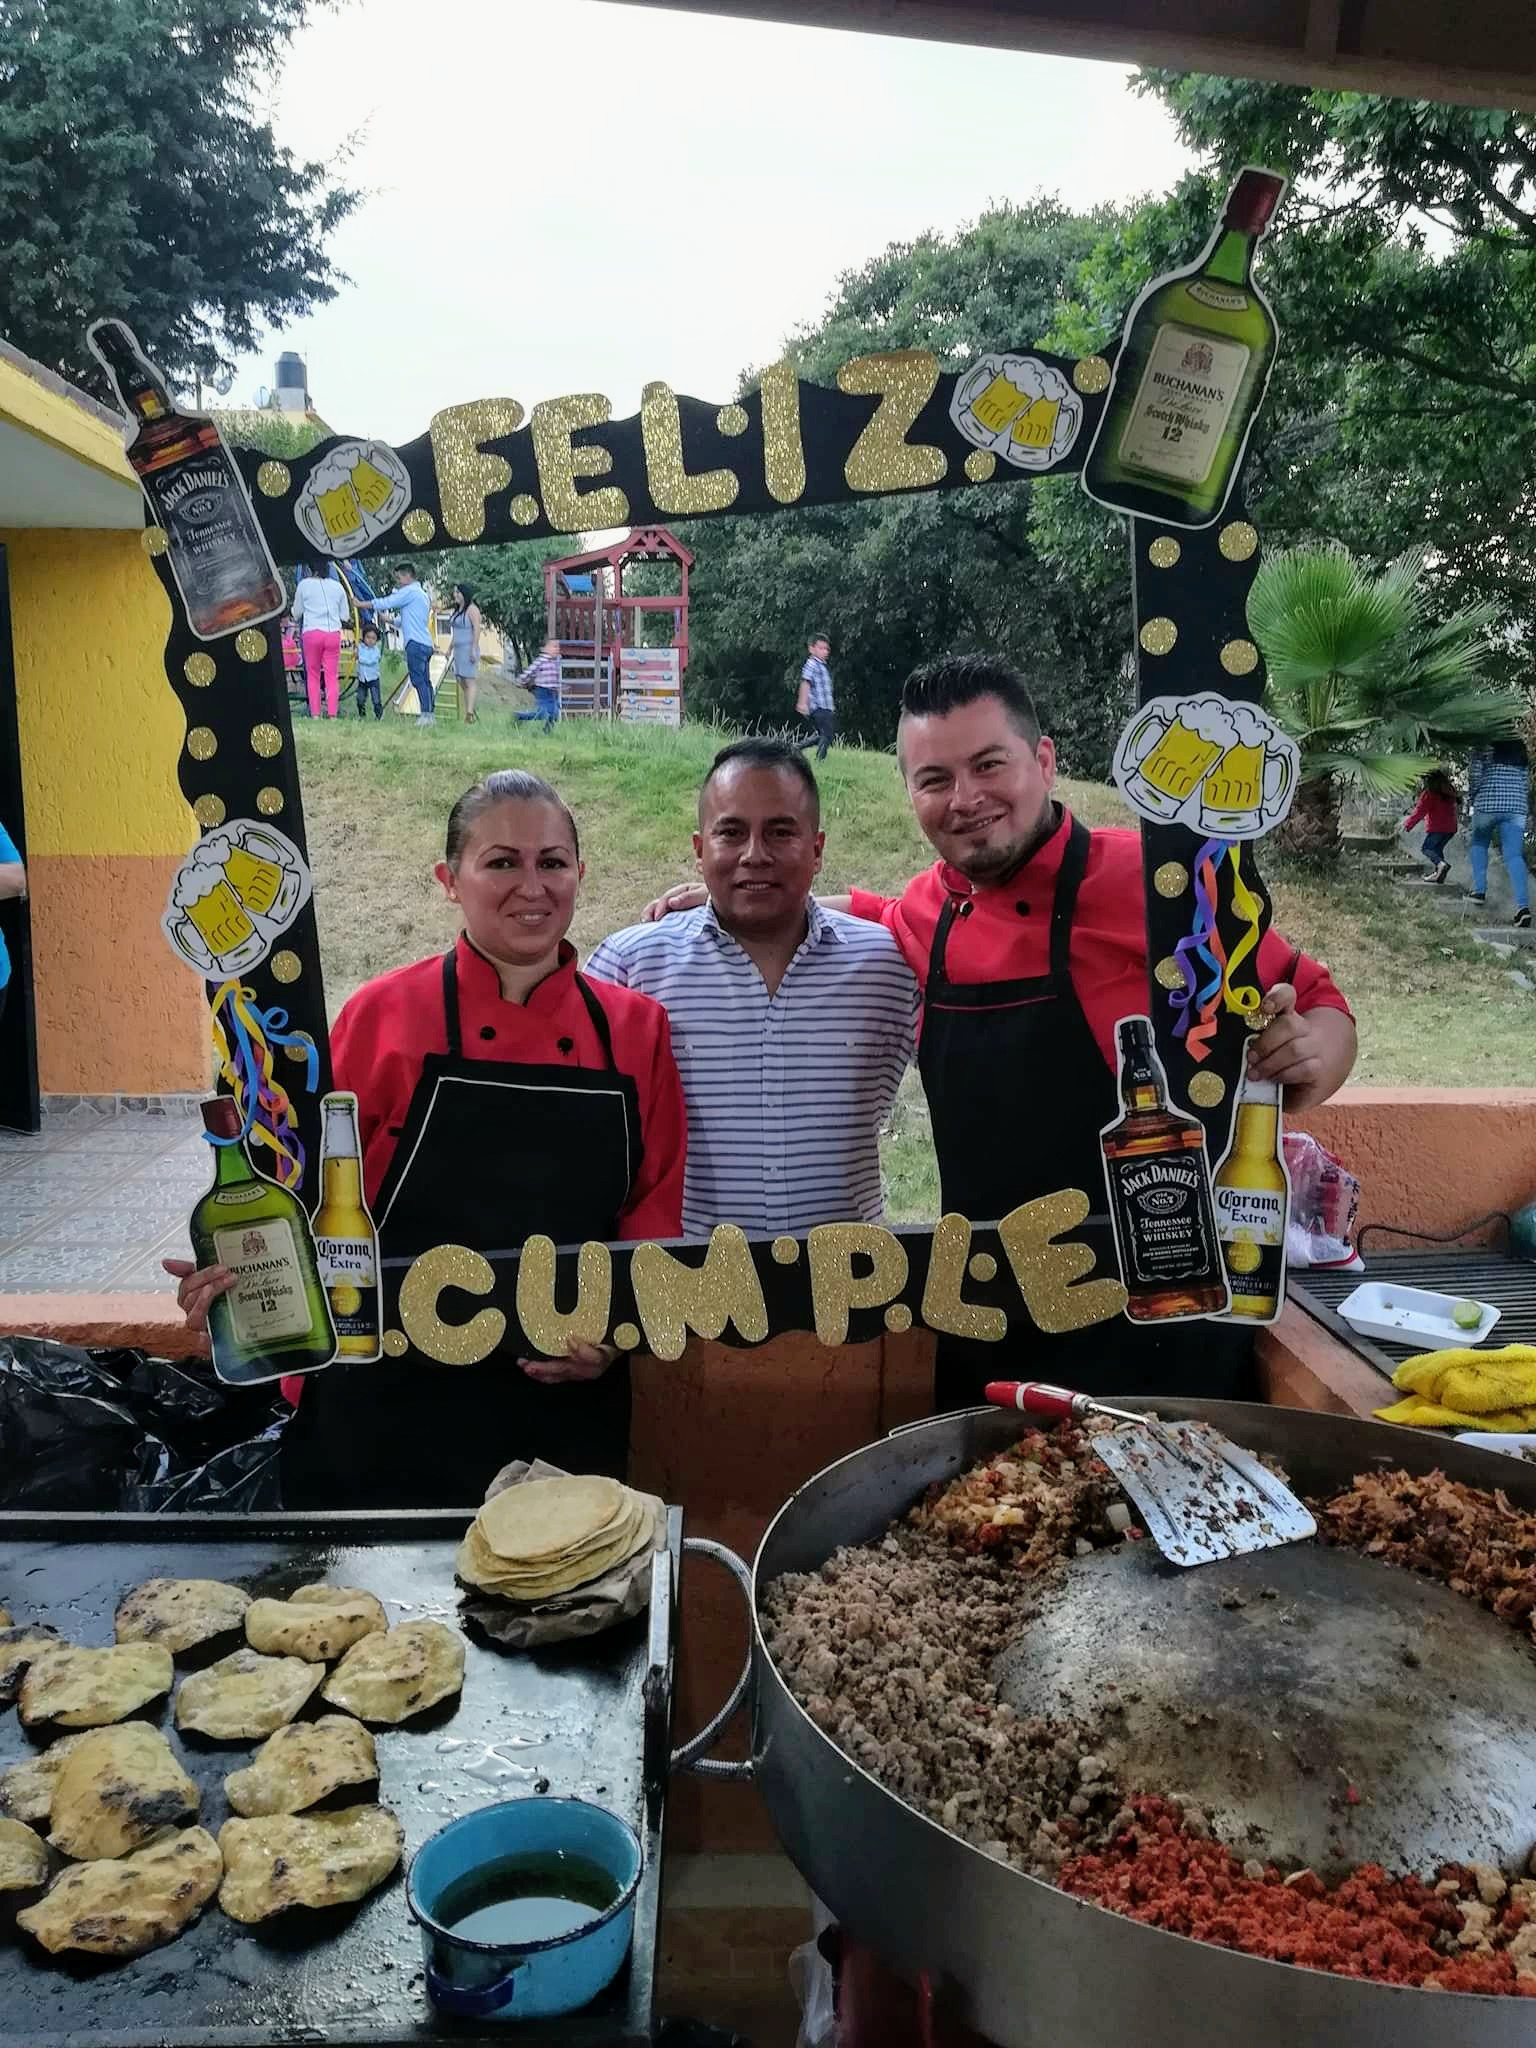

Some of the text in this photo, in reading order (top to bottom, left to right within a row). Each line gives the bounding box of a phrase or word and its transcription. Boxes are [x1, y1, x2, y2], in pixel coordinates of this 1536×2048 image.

[1152, 371, 1225, 401] BUCHANAN'S
[1144, 404, 1211, 434] Scotch Whisky
[1161, 425, 1183, 443] 12
[161, 468, 229, 511] JACK DANIEL'S
[186, 520, 233, 541] Tennessee
[192, 532, 236, 555] WHISKEY
[1121, 1165, 1200, 1196] JACK DANIEL'S
[1218, 1189, 1281, 1215] Corona
[1140, 1216, 1192, 1229] Tennessee
[1232, 1209, 1268, 1224] Extra
[1143, 1230, 1192, 1242] WHISKEY
[318, 1239, 372, 1260] Corona
[330, 1257, 362, 1269] Extra
[399, 1188, 1129, 1365] CUMPLE
[238, 1285, 294, 1305] Scotch Whisky
[260, 1299, 277, 1313] 12
